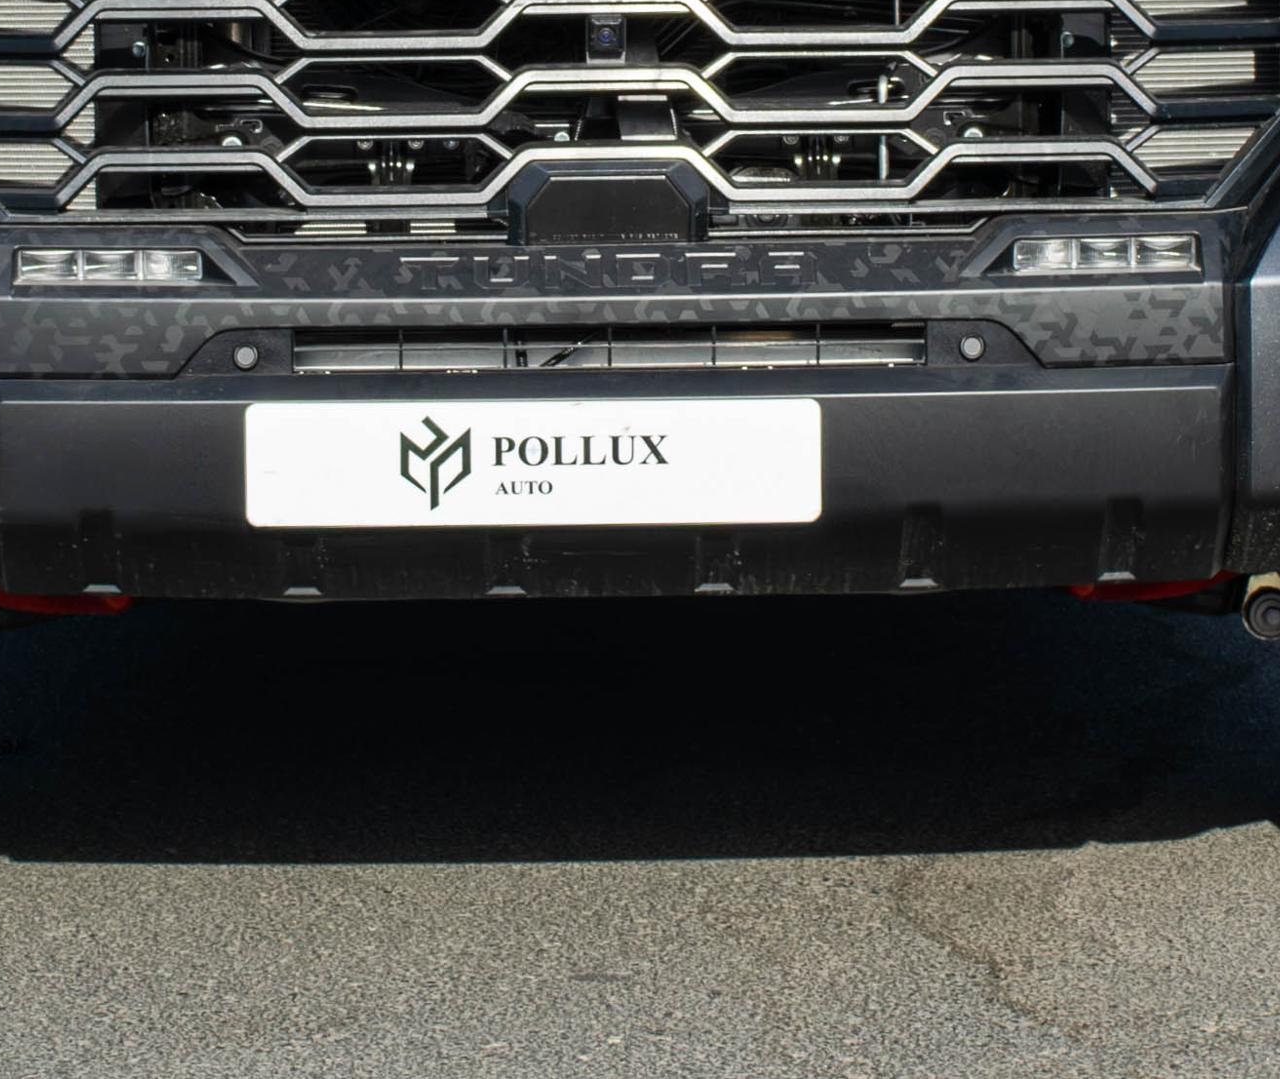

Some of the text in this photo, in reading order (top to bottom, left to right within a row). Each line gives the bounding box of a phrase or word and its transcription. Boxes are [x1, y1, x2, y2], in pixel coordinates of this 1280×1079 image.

[399, 251, 819, 291] TUNDRA
[492, 434, 670, 467] POLLUX
[495, 479, 554, 496] AUTO
